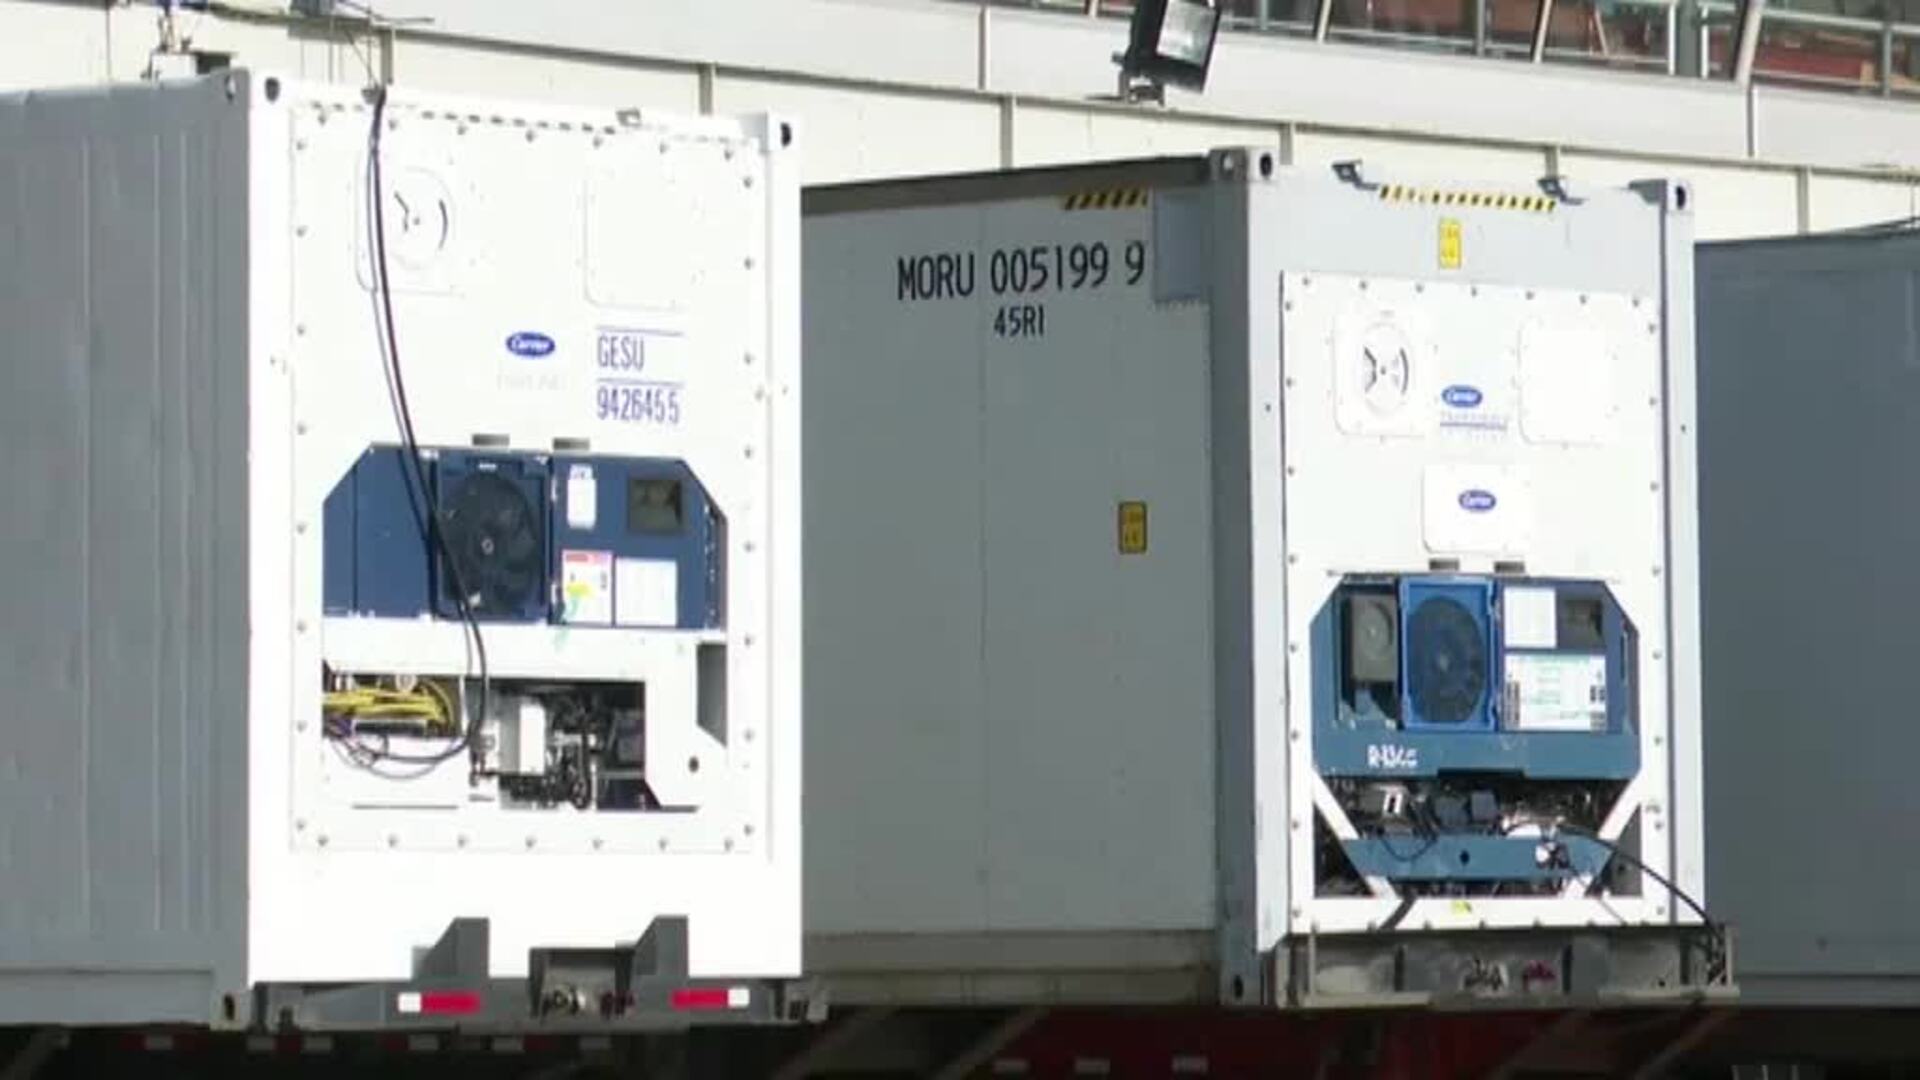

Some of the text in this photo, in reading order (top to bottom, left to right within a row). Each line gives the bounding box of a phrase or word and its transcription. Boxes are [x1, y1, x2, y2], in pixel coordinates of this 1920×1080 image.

[897, 240, 1145, 300] MORU 005199 9
[597, 335, 645, 371] GESU
[597, 387, 680, 424] 9426455
